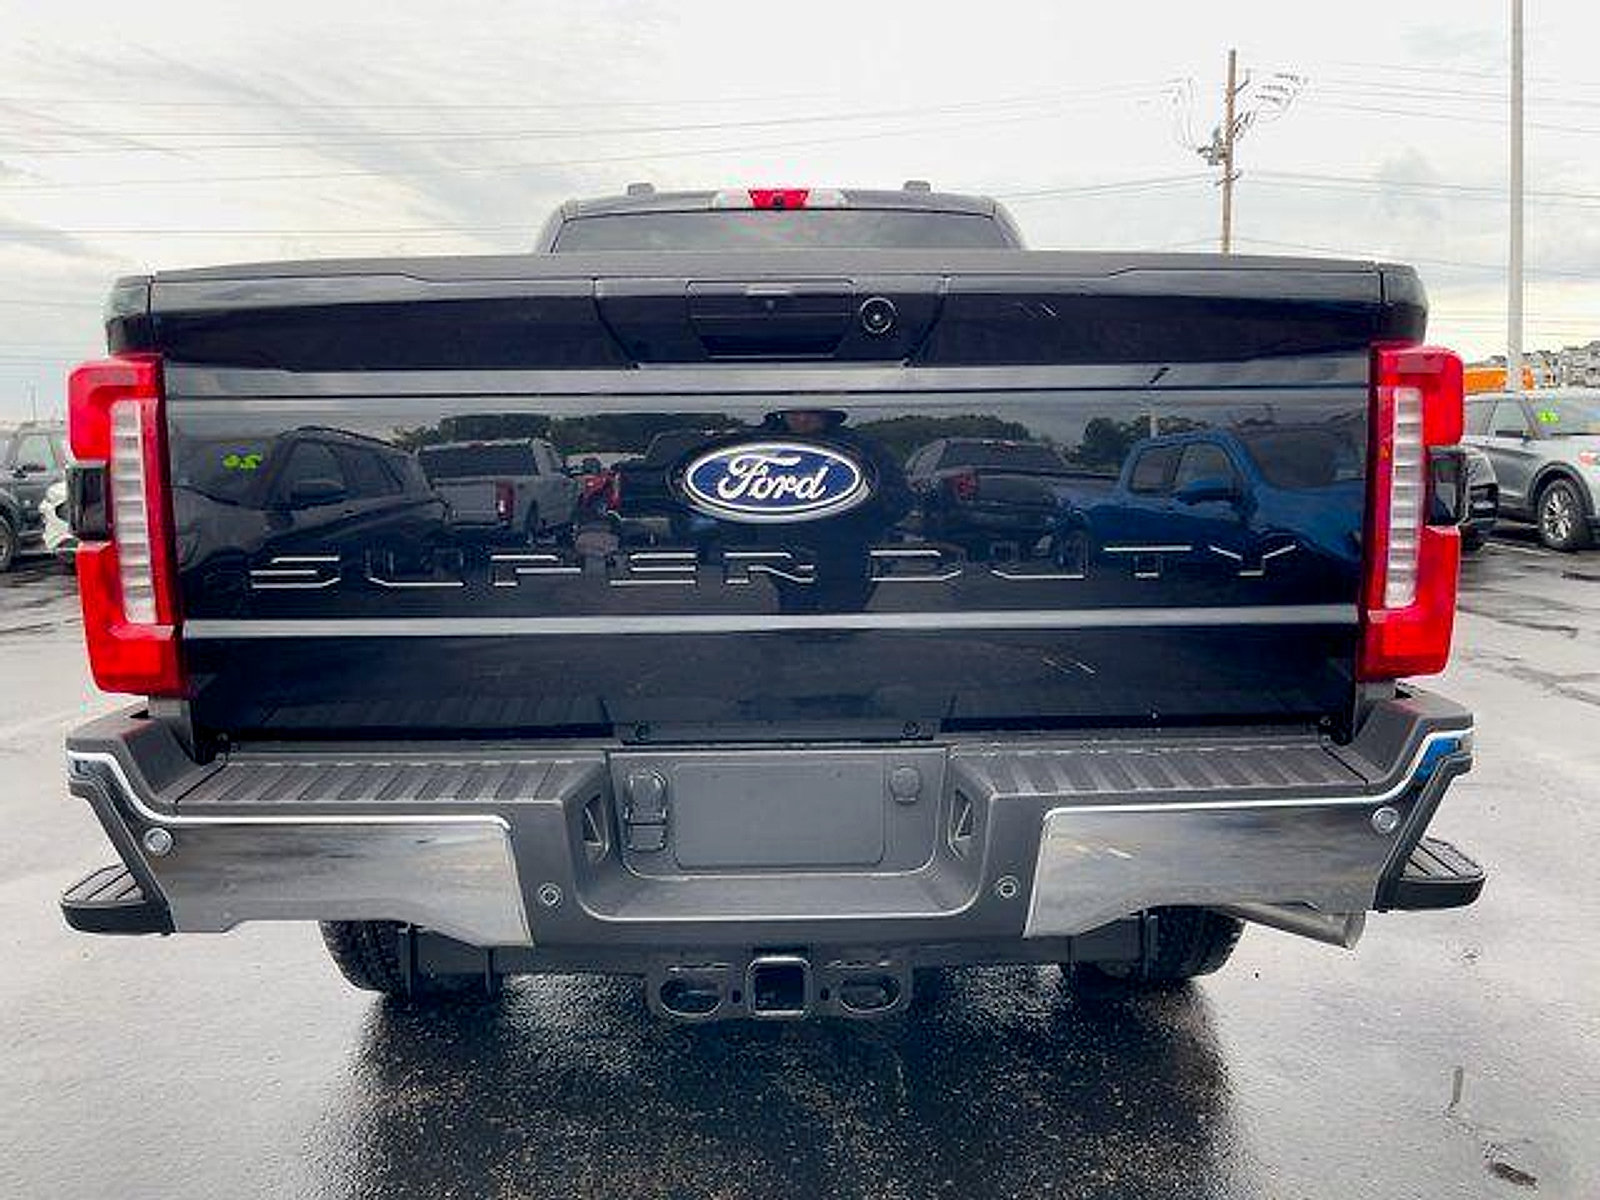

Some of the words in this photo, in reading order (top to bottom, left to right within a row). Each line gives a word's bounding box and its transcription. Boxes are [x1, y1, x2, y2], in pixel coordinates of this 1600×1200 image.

[718, 454, 829, 500] Ford
[249, 551, 815, 589] SUPER
[869, 543, 1297, 582] DUTY
